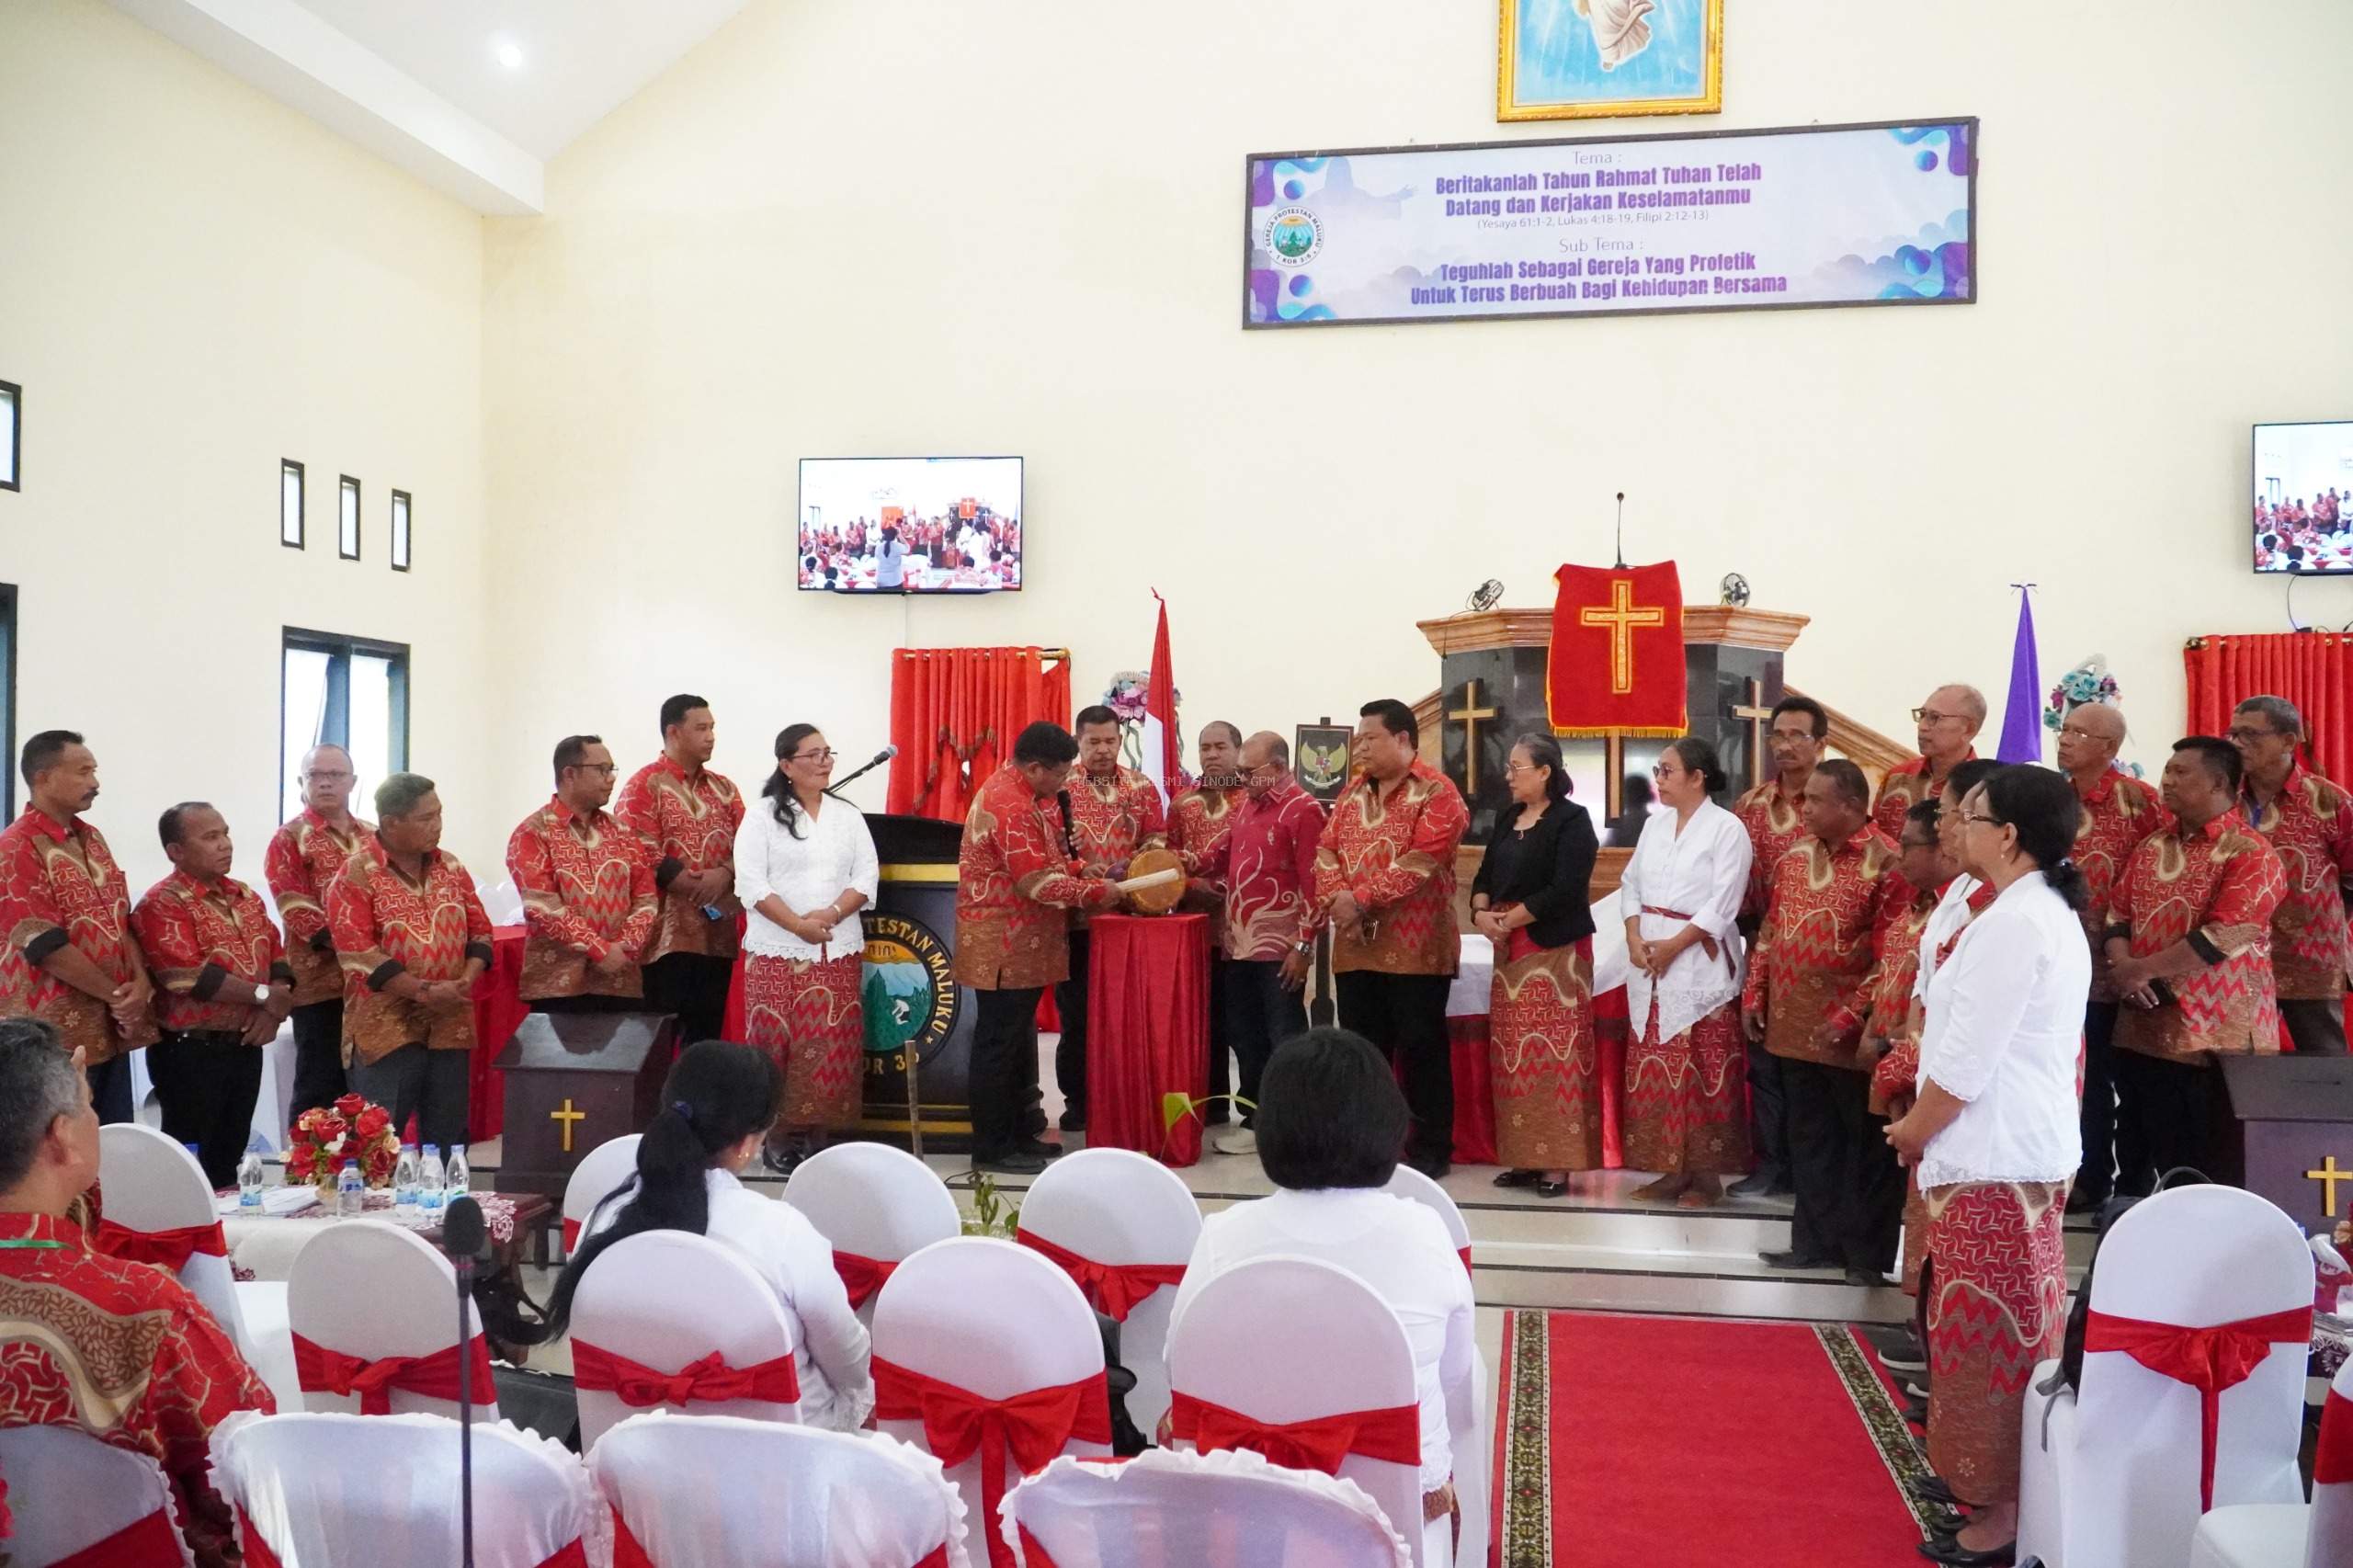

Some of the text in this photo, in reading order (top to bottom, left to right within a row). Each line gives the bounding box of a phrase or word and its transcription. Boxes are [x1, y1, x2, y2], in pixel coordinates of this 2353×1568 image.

[1574, 151, 1612, 165] Tema
[1436, 163, 1761, 194] Beritakanlah Tahun Rahmat Tuhan Telah
[1446, 188, 1751, 217] Datang dan Kerjakan Keselamatanmu
[1477, 218, 1517, 230] (Yesaya
[1558, 215, 1587, 226] Lukas
[1636, 210, 1662, 224] Filipi
[1665, 210, 1709, 222] 2:12-13)
[1559, 237, 1588, 253] Sub
[1596, 236, 1633, 252] Tema
[1440, 252, 1756, 282] Teguhlah Sebagai Gereja Yang Profetik
[1411, 276, 1787, 304] Untuk Terus Berbuah Bagi Kehidupan Bersama
[926, 951, 954, 1035] MALUKU
